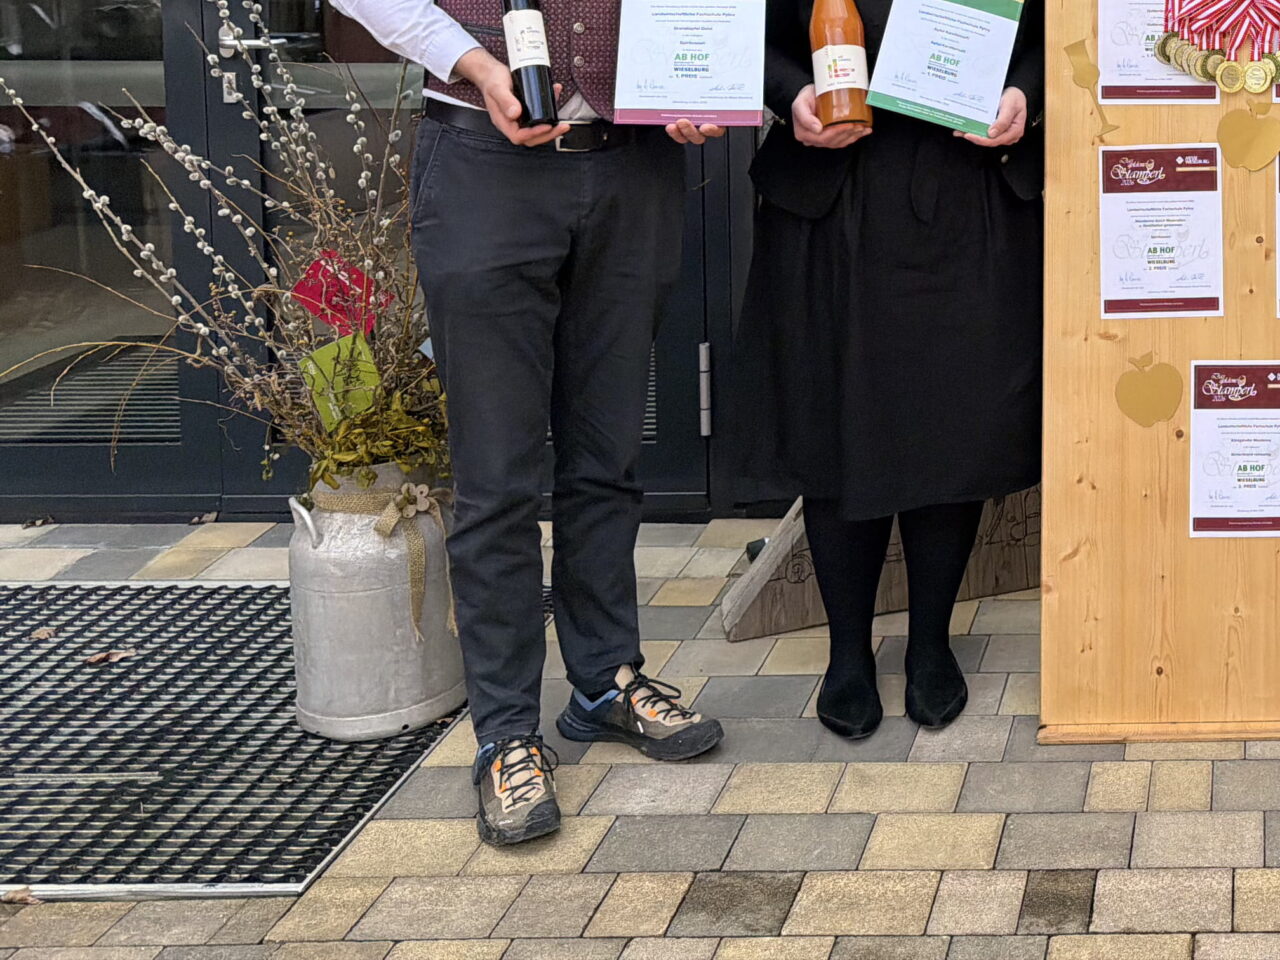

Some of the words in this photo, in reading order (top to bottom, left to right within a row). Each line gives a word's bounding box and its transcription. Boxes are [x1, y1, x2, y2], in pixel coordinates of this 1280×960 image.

[930, 53, 942, 62] AB
[943, 56, 961, 67] HOF
[1110, 164, 1166, 182] Stamperl
[1202, 380, 1257, 398] Stamperl
